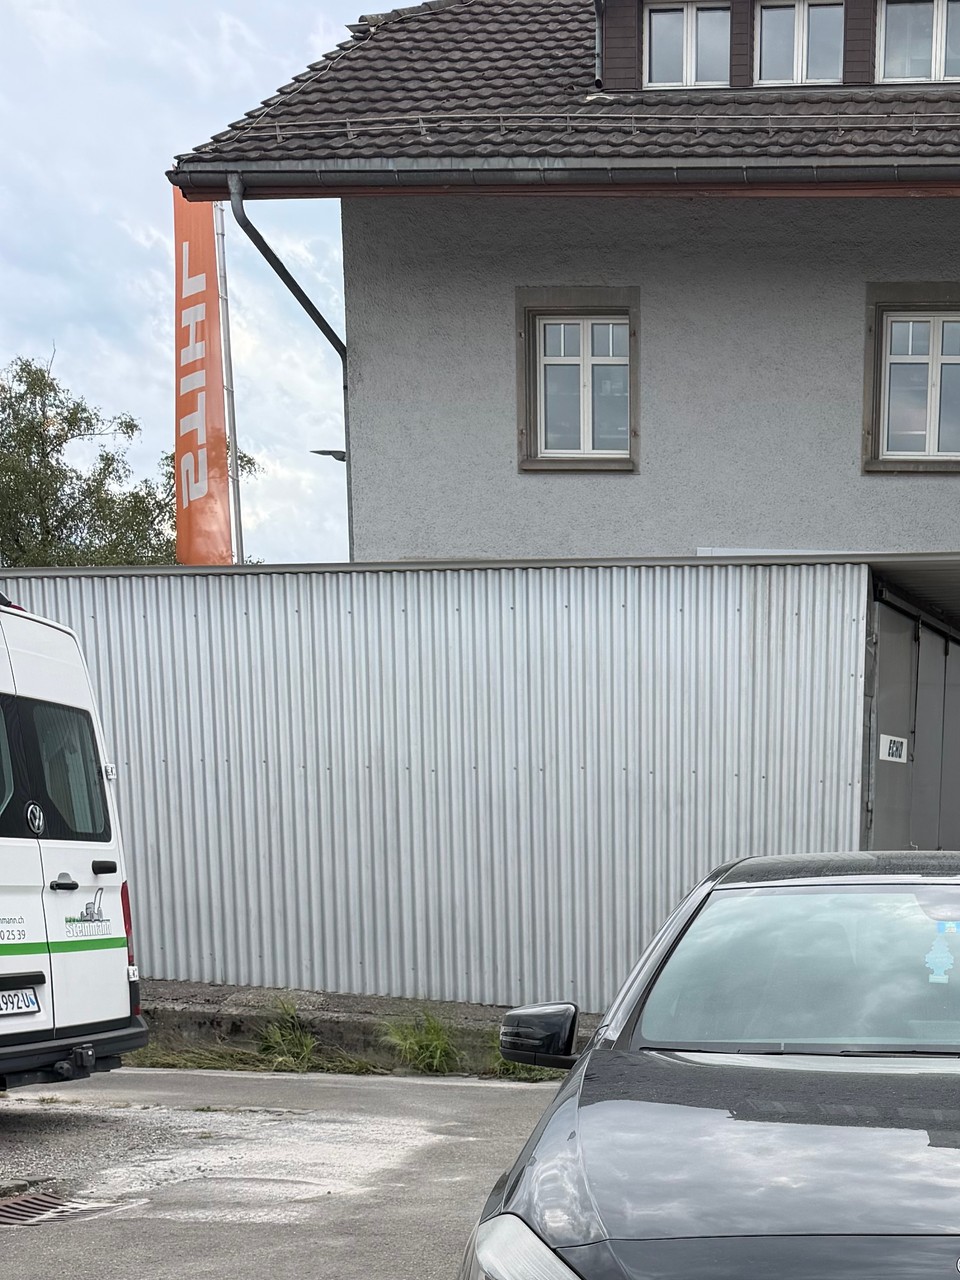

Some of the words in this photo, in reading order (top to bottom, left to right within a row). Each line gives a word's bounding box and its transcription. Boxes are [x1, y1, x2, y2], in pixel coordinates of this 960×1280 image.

[6, 930, 16, 940] 25
[17, 929, 26, 940] 39
[65, 922, 112, 938] Steinmann
